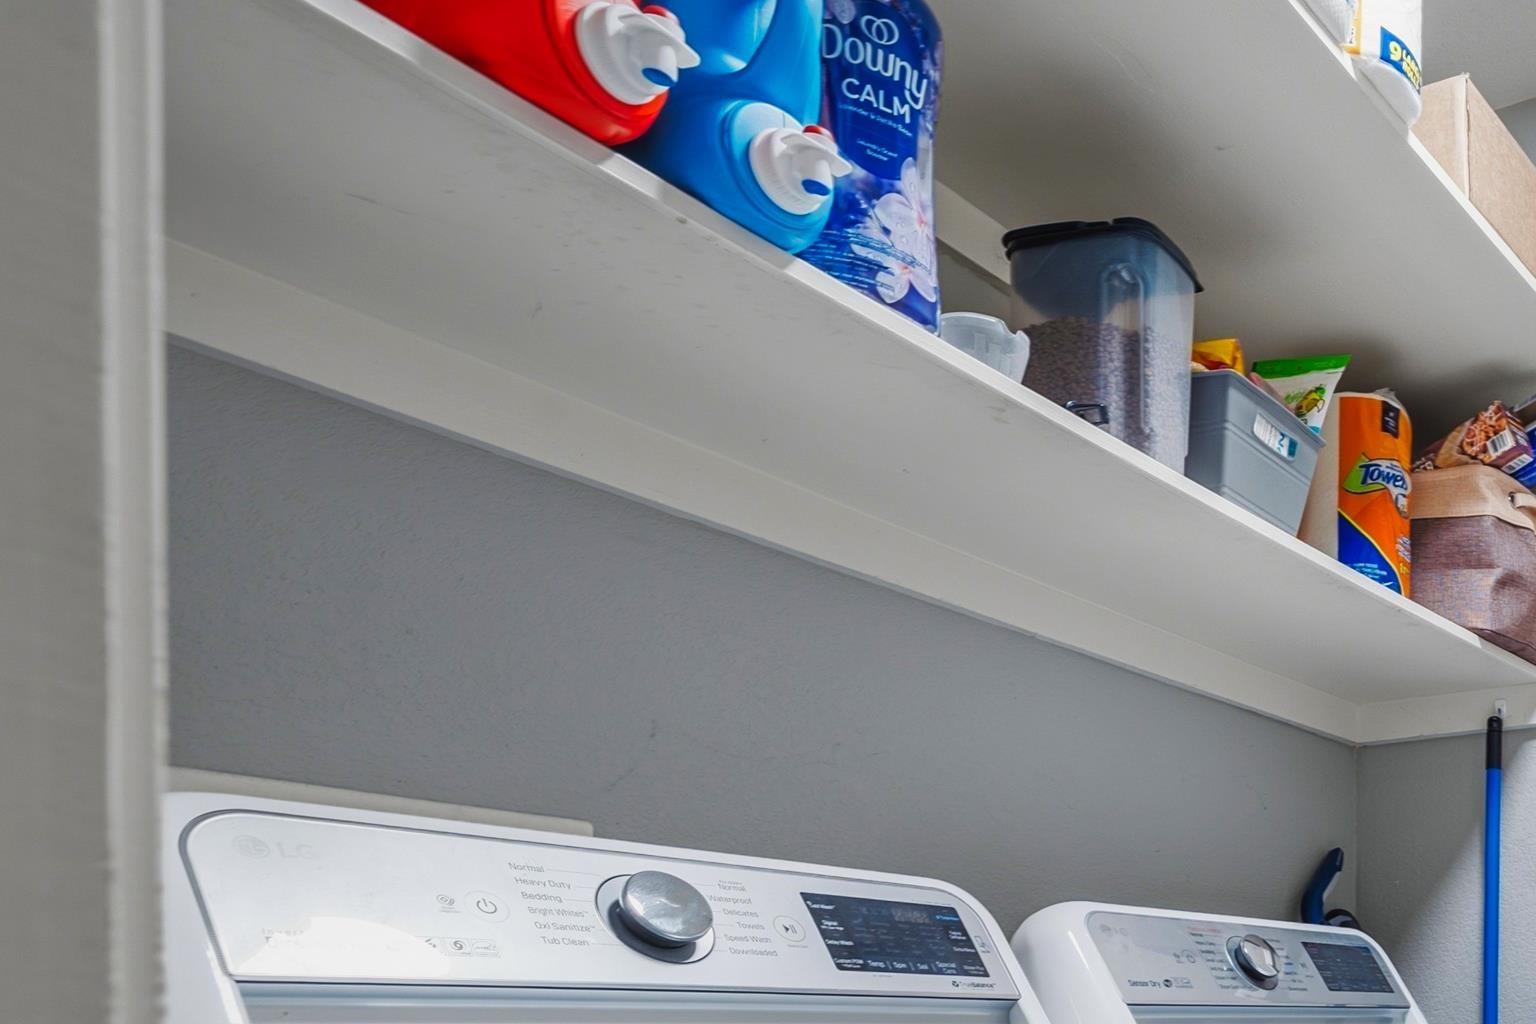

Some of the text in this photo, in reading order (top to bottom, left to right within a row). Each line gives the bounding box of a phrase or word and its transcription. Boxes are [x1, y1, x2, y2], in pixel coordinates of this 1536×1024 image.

[1388, 40, 1402, 62] 9
[821, 23, 928, 110] Downy
[841, 77, 911, 124] CALM
[507, 861, 545, 873] Normal
[513, 876, 571, 890] Heavy Duty
[520, 891, 563, 903] Bedding
[527, 905, 554, 917] Bright
[540, 935, 590, 947] Tub Clean
